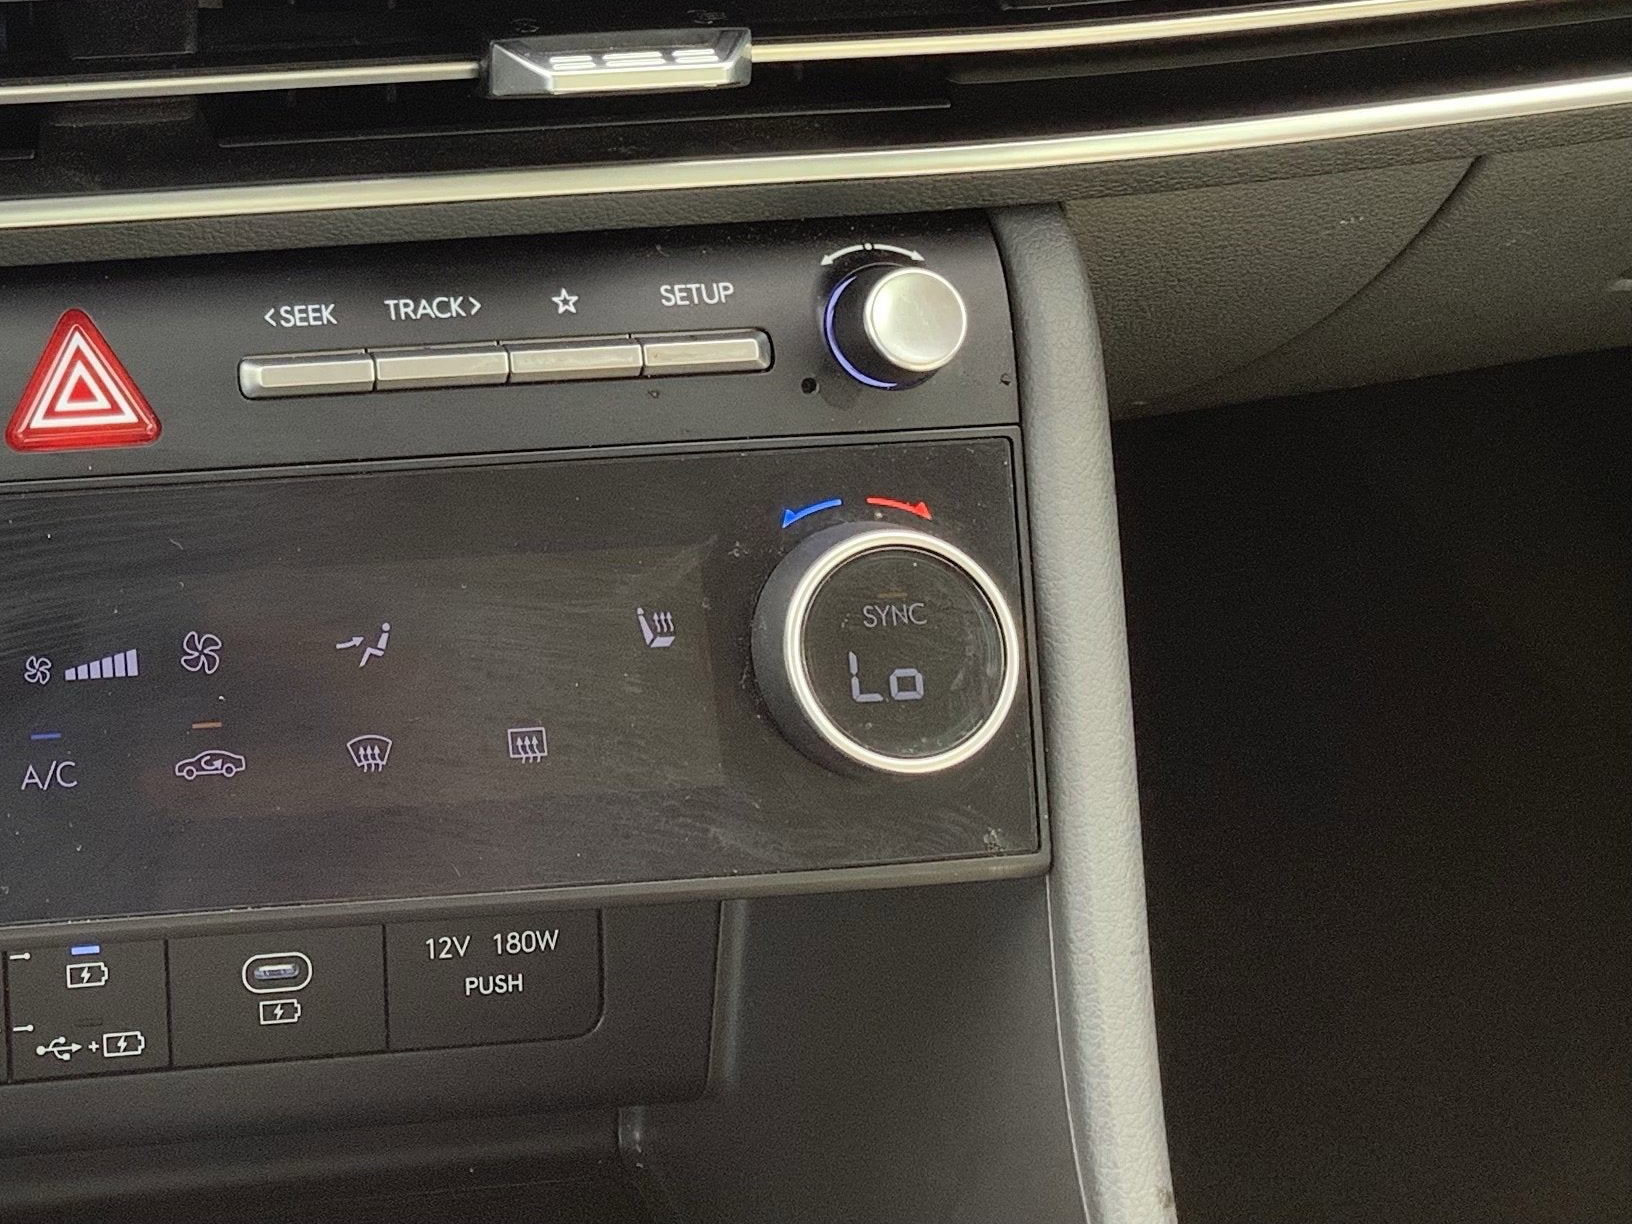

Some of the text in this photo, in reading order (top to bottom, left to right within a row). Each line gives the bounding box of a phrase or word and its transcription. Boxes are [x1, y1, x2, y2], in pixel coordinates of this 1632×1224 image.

[659, 281, 735, 307] SETUP
[862, 602, 928, 628] SYNC
[20, 760, 79, 791] A/C
[425, 929, 559, 960] 12V 180W
[465, 973, 524, 996] PUSH
